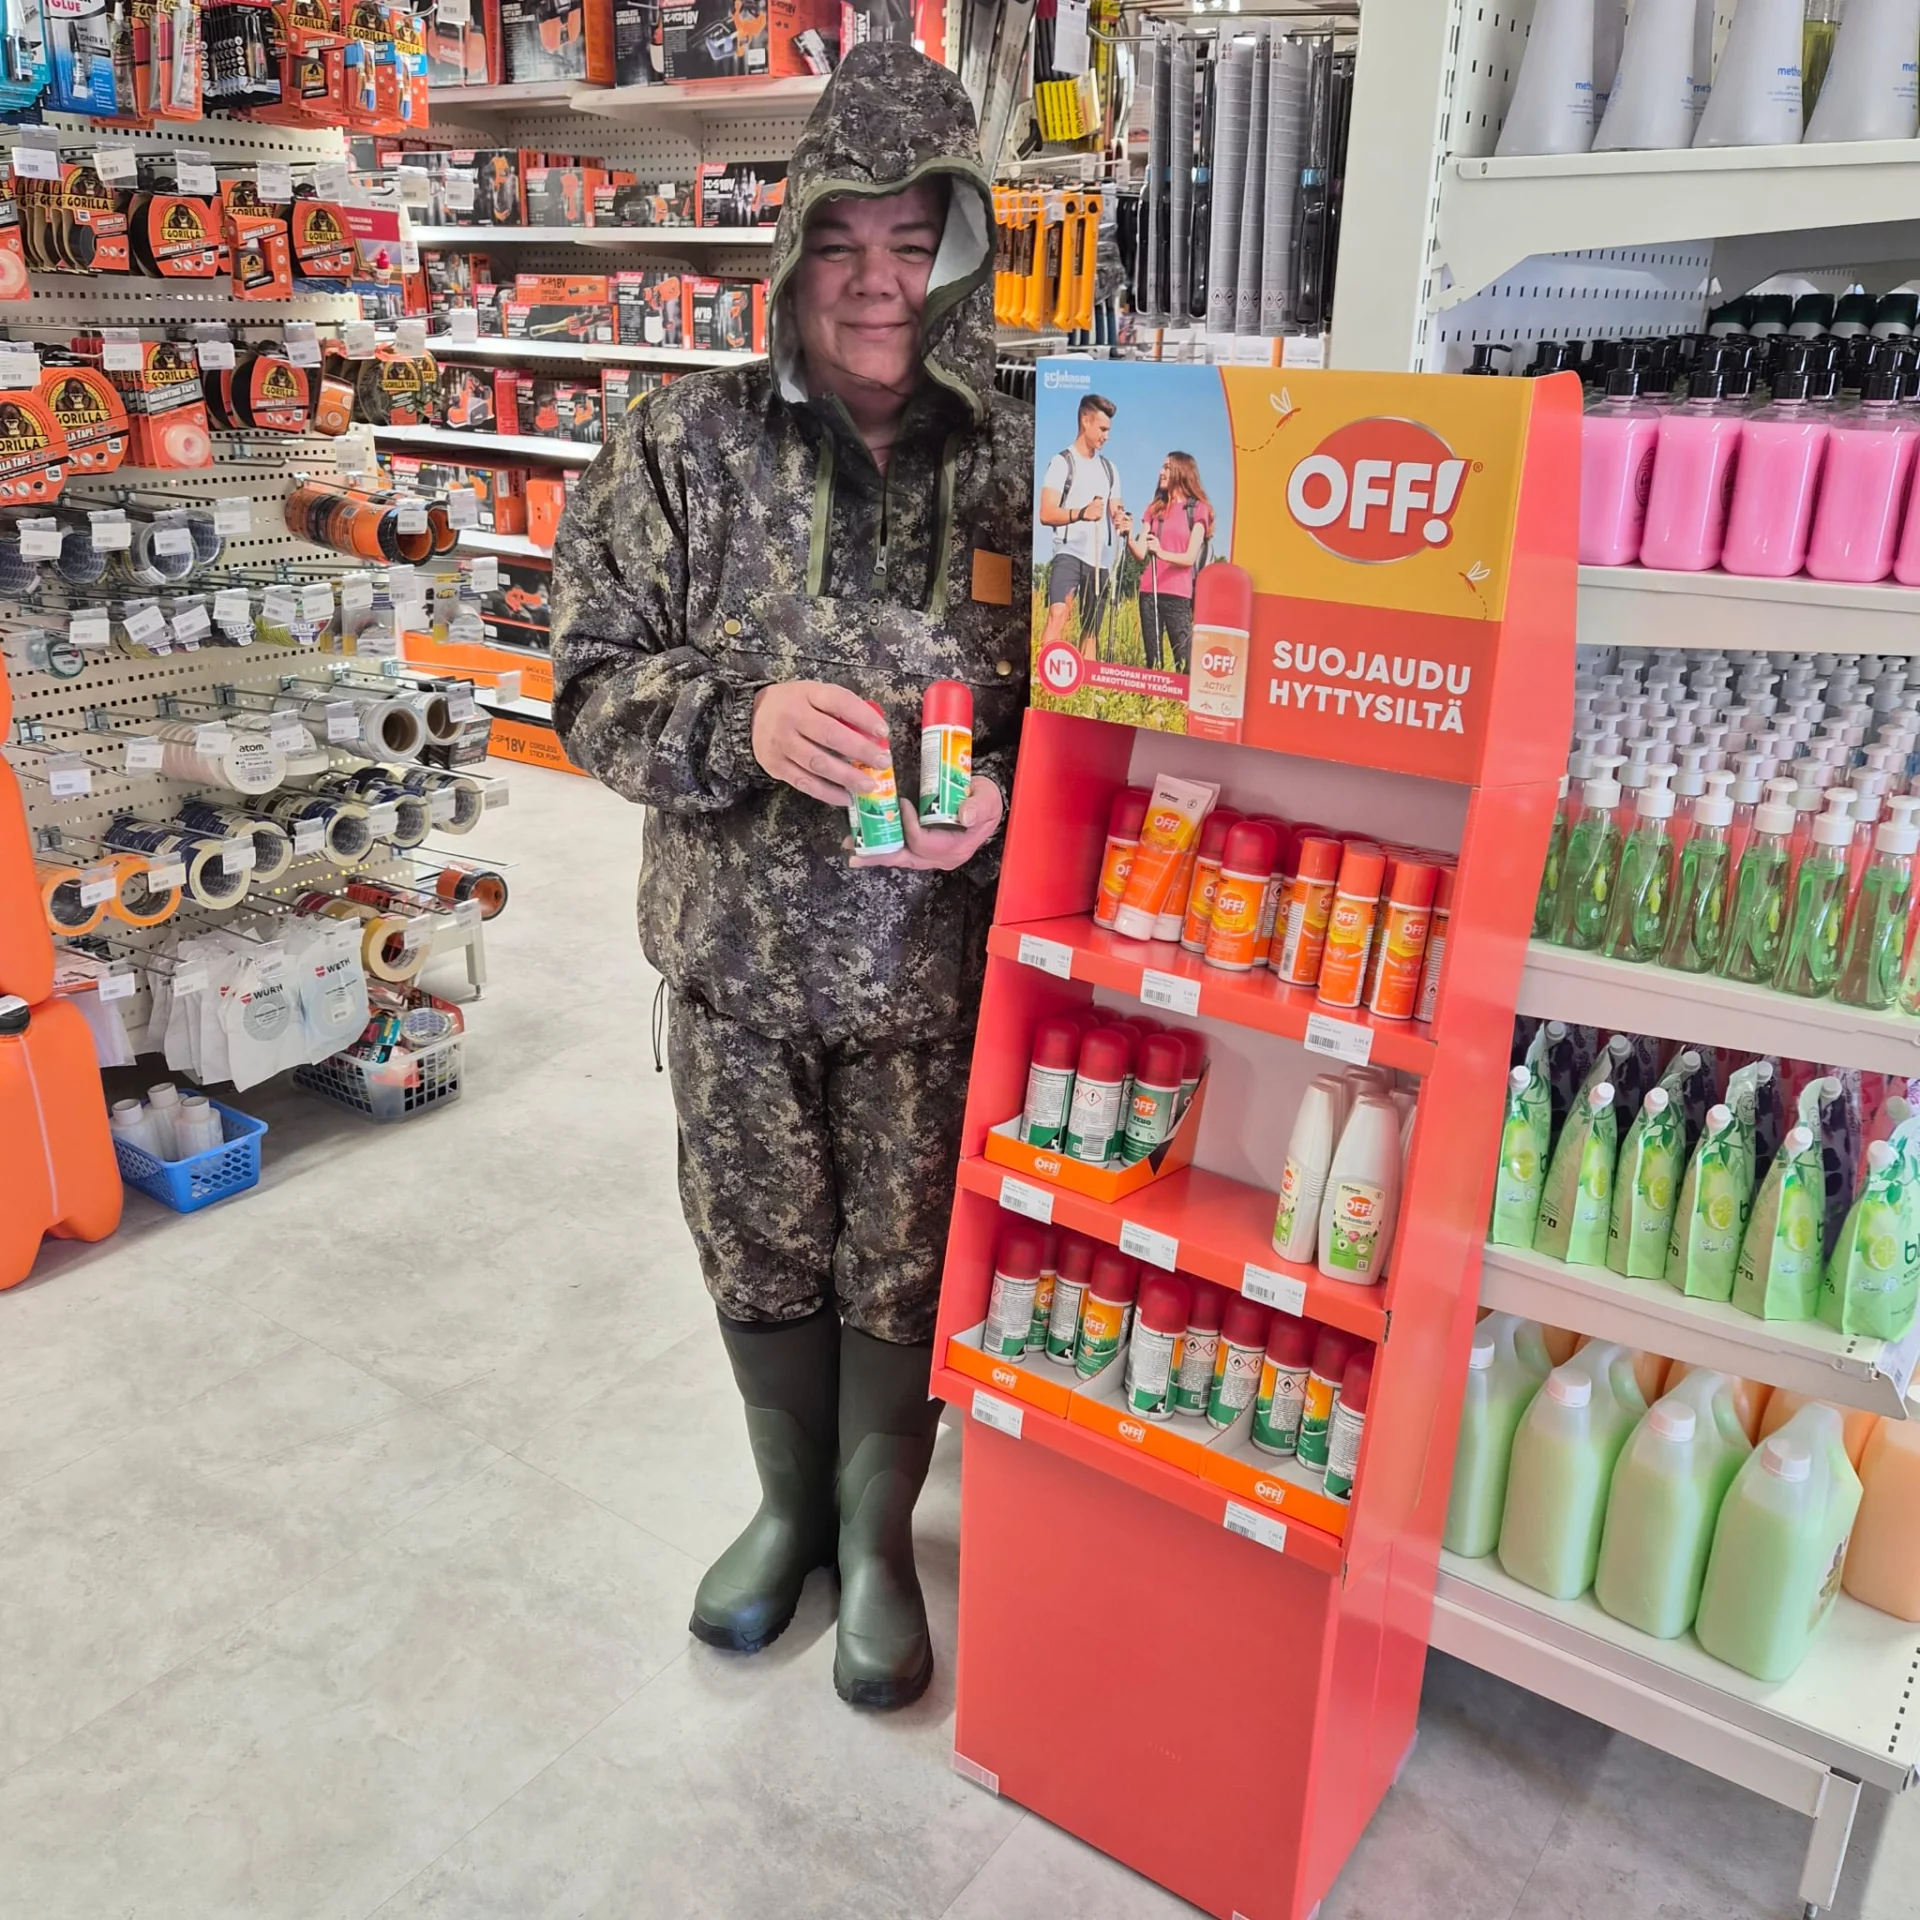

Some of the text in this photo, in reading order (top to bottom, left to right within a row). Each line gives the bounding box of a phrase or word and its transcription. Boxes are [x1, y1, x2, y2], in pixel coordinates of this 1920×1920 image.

[54, 0, 81, 13] GLUE
[293, 15, 326, 31] GORILLA
[352, 30, 393, 43] GORILLA
[396, 43, 421, 55] ORILLA
[1777, 65, 1802, 77] metho
[67, 197, 109, 210] GORILLA
[231, 207, 268, 218] GORILLA
[166, 229, 202, 240] GORILLA
[308, 231, 338, 241] GORILLA
[180, 242, 192, 251] TAPE
[151, 370, 192, 381] GORILLA
[150, 383, 196, 402] MOUNTING TAPE
[265, 385, 296, 397] GORILLA
[77, 427, 95, 438] TAPE
[0, 438, 41, 451] ORILLA
[13, 455, 32, 466] TAPE
[1287, 455, 1471, 549] OFF!
[1201, 653, 1237, 675] OFF!
[1272, 640, 1471, 695] SUOJAUDU
[1100, 666, 1175, 685] EUROOPAN HYTTYS-
[1091, 674, 1146, 689] KARKOTTEIDEN
[1147, 682, 1184, 696] YKKÖNEN
[1203, 680, 1233, 692] ACTIVE
[1268, 677, 1465, 735] HYTTYSILTÄ
[239, 744, 264, 752] atom
[1154, 814, 1181, 832] OFF!
[1115, 863, 1132, 876] OF
[1218, 898, 1247, 914] OFF!
[1335, 910, 1360, 924] OFF!
[1132, 1097, 1158, 1116] OFF!
[1034, 1157, 1061, 1176] OFF!
[1344, 1200, 1374, 1217] OFF!
[1039, 1292, 1053, 1304] OF
[1083, 1317, 1107, 1335] OFF!
[991, 1370, 1018, 1389] OFF!
[1118, 1422, 1147, 1444] OFF!
[1255, 1483, 1285, 1505] OFF!
